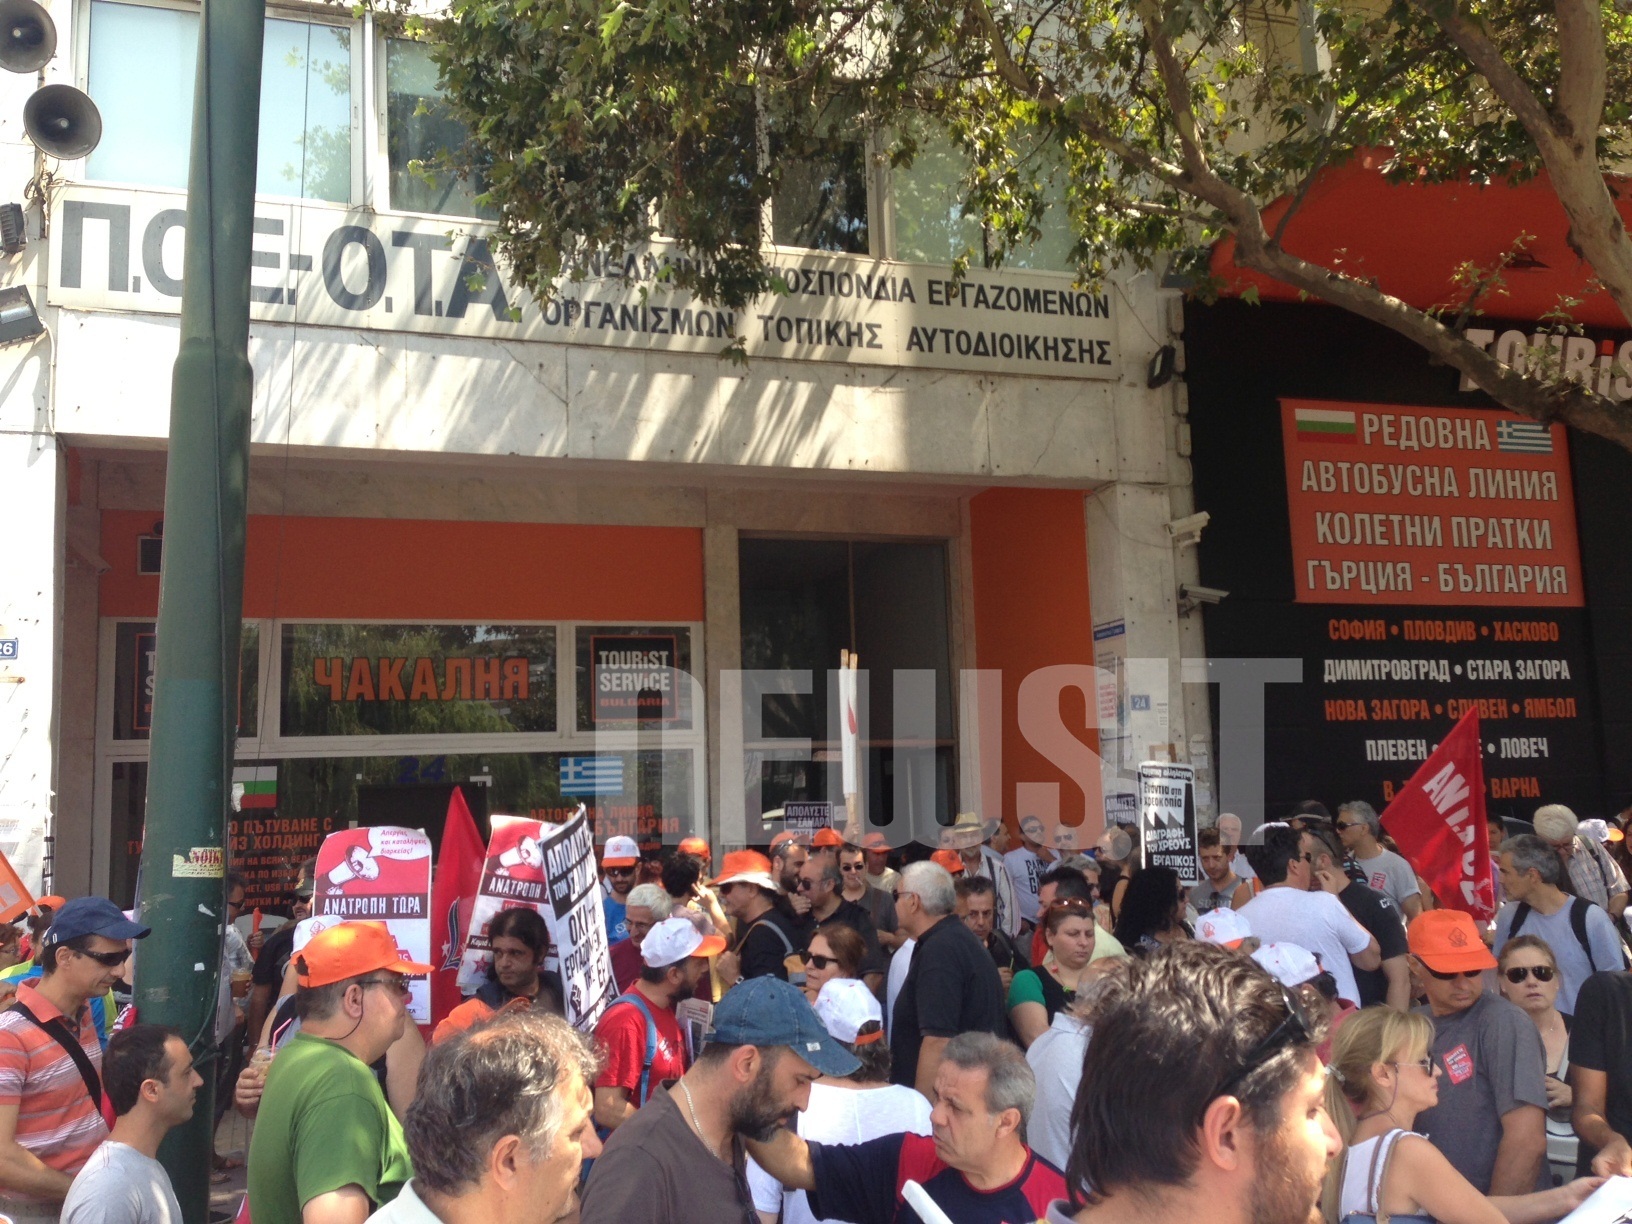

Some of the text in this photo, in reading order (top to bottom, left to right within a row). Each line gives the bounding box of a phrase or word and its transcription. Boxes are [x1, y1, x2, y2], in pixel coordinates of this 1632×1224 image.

[927, 279, 1110, 319] ΕΡΓΑΖΟΜΕΝΩΝ
[542, 299, 1112, 366] ΟΡΓΑΝΙΣΜΩΝ ΤΟΠΙΚΗΣ ΑΥΤΟΔΙΟΙΚΗΣΗΣ
[1362, 412, 1492, 452] РЕДОВНА
[1301, 460, 1559, 501] АВТОБУСНА ЛИНИЯ
[1315, 511, 1553, 550] КОЛЕТНИ ПРАТКИ
[1306, 559, 1413, 595] ГЪРЦИЯ
[1437, 562, 1569, 595] БЪЛГАРИЯ
[1328, 618, 1560, 643] СОФИЯ ПЛОВДИВ ХАСКОВО
[313, 656, 530, 701] ЧАКАЛНЯ
[1323, 659, 1571, 684] ДИМИТРОВГРАД СТАРА ЗАГОРА
[1133, 697, 1147, 709] 24
[1324, 699, 1368, 722] НОВА
[1371, 699, 1431, 721] ЗАГОРА
[1524, 698, 1577, 719] ЯМБОЛ
[1365, 739, 1428, 761] ПЛЕВЕН
[1500, 737, 1549, 759] ЛОВЕЧ
[1491, 777, 1541, 799] ВАРНА
[243, 817, 318, 834] ПЪТУВАНЕ
[1146, 827, 1185, 841] ΔΙΑΓΡΑΦΗ
[253, 833, 321, 850] ХОЛДИНГ
[1157, 837, 1191, 852] ΧΡΕΟΥΣ
[1153, 854, 1195, 867] ΕΡΓΑΤΙΚΟΣ
[488, 877, 542, 900] ΑΝΑΤΡΟΠΗ
[323, 896, 421, 915] ΑΝΑΤΡΟΠΗ ΤΩΡΑ
[568, 904, 589, 947] ΟΧΙ
